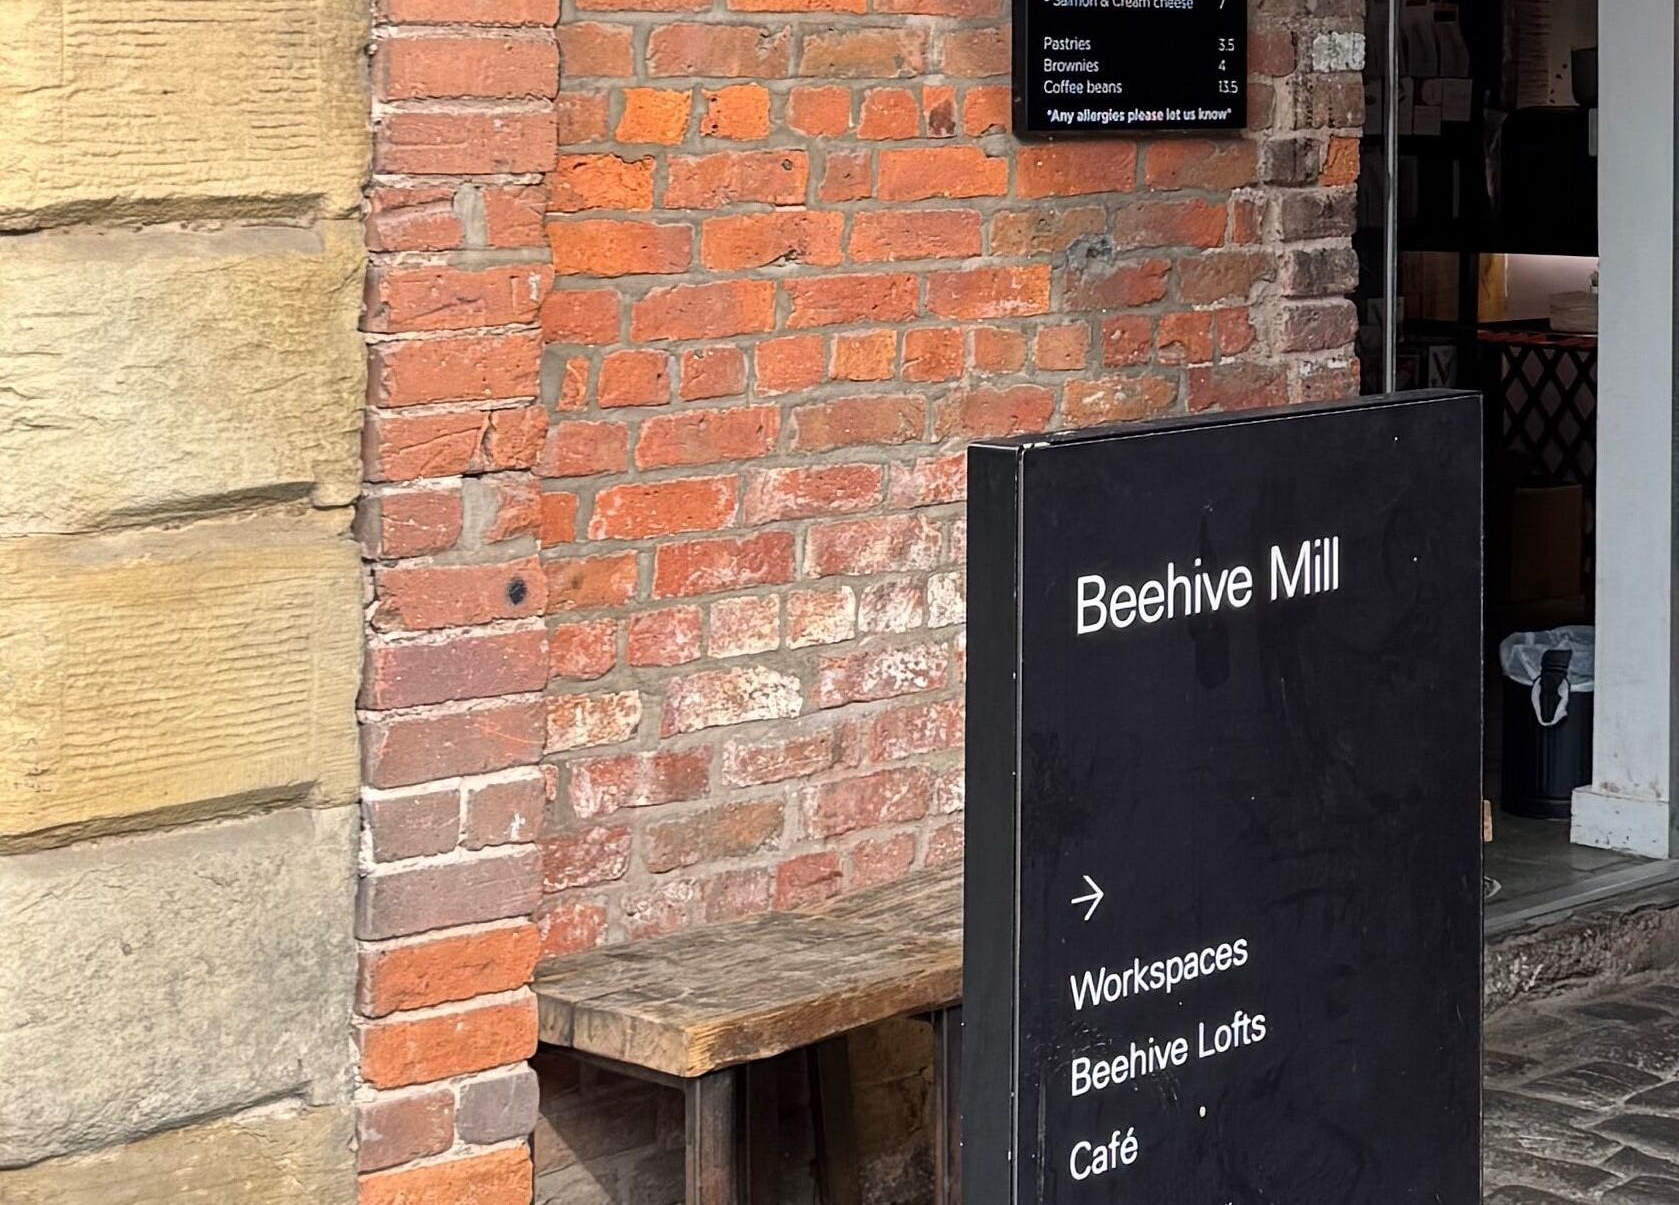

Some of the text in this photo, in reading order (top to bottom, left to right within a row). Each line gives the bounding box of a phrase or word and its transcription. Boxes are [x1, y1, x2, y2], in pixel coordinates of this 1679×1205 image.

[1043, 36, 1092, 51] Pastries
[1043, 57, 1226, 73] Brownies 4
[1043, 79, 1084, 95] Coffee
[1086, 79, 1123, 94] beans
[1076, 108, 1126, 125] allergies
[1127, 107, 1165, 124] please
[1165, 107, 1182, 121] let
[1182, 109, 1197, 121] us
[1076, 535, 1340, 636] Beehive Mill
[1069, 938, 1249, 1011] Workspaces
[1071, 1009, 1267, 1097] Beehive Lofts
[1069, 1126, 1139, 1181] Café
